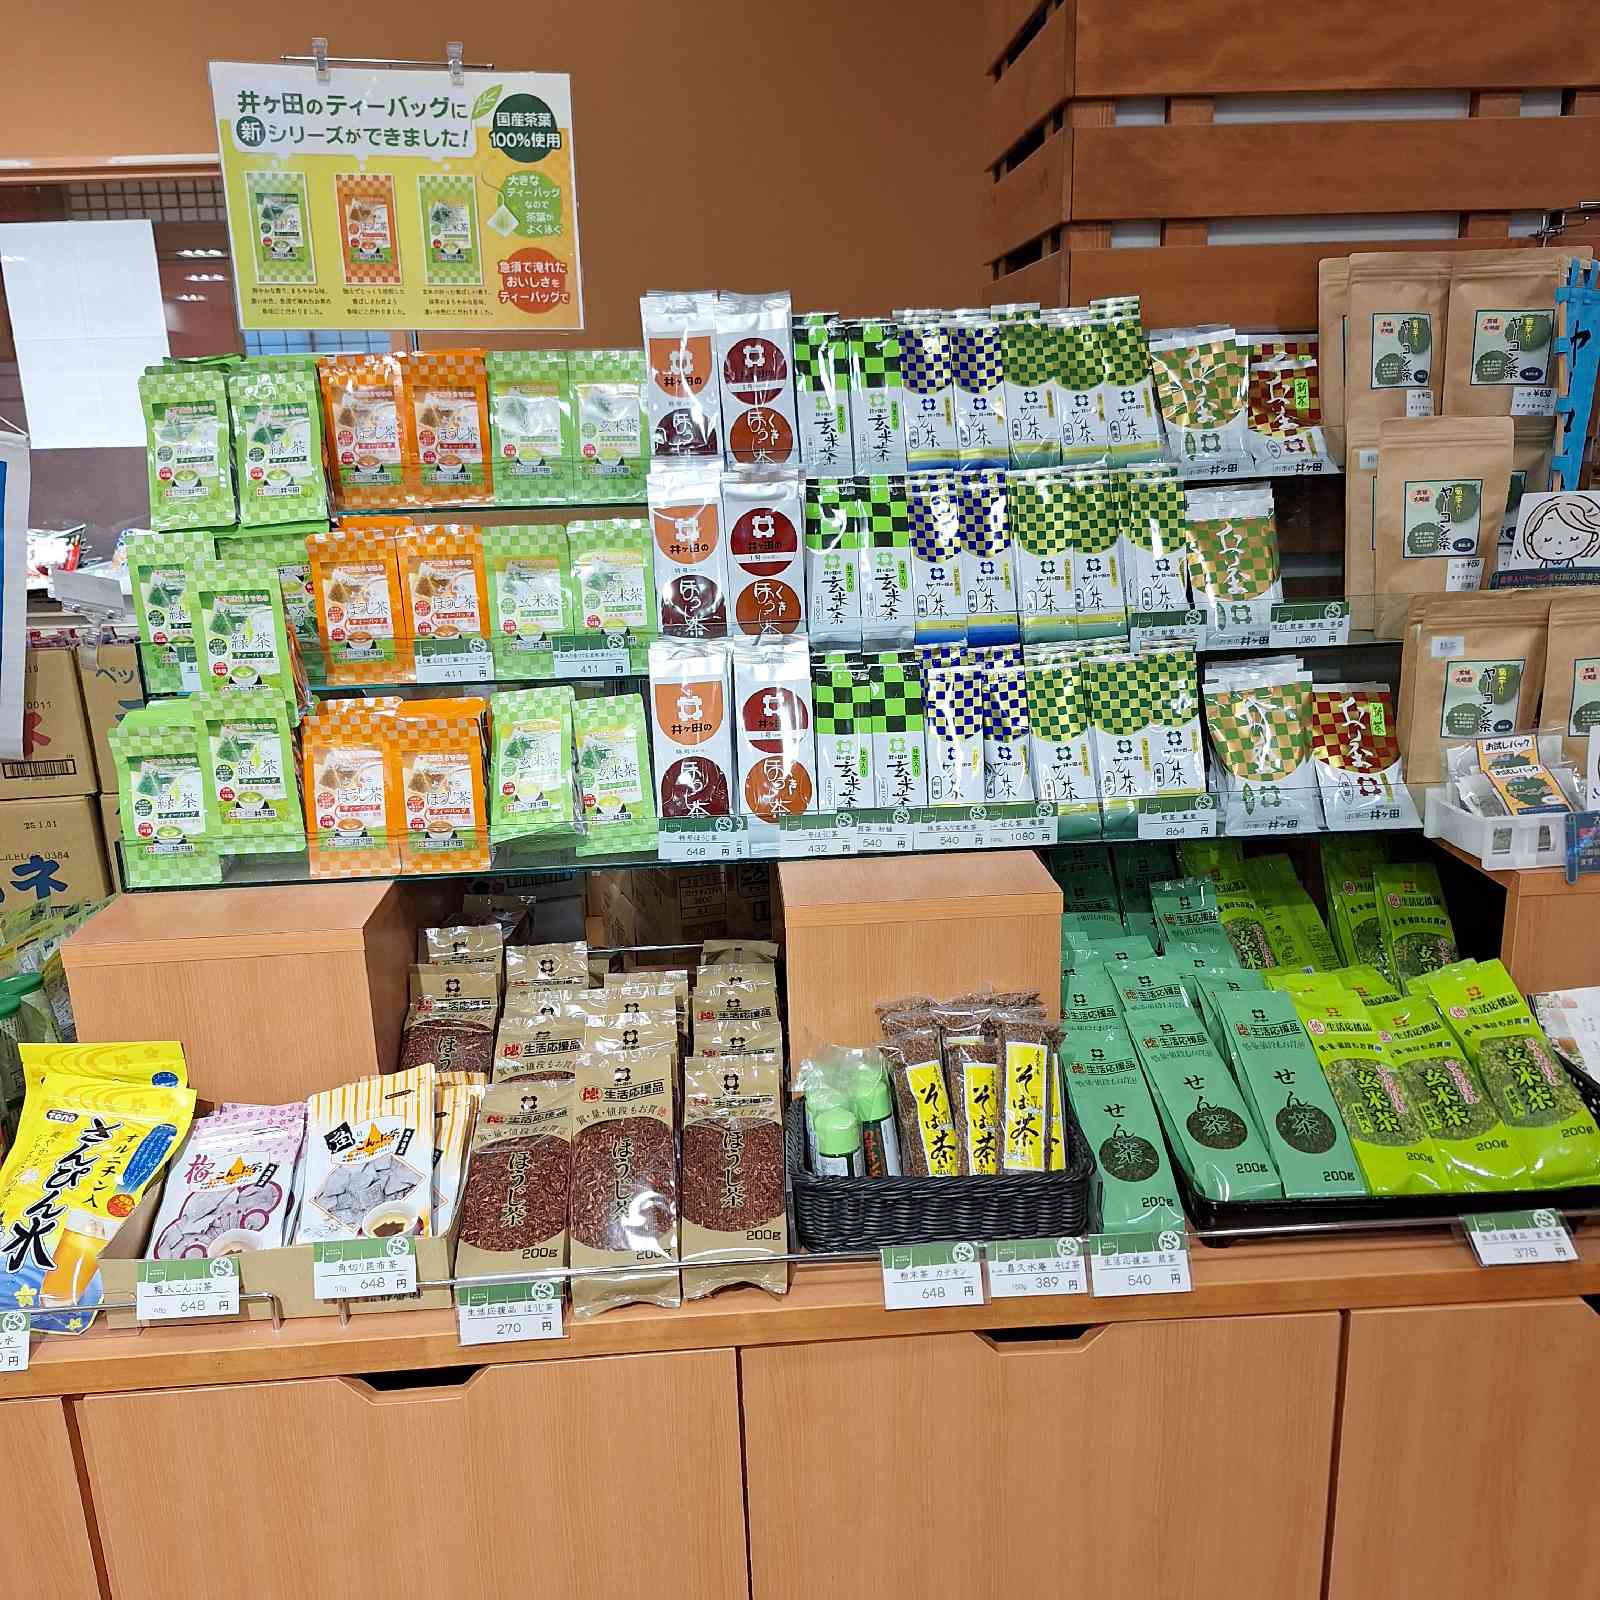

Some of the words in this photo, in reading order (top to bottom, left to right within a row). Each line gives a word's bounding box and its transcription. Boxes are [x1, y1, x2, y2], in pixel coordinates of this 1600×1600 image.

[237, 89, 468, 121] 井ヶ田のティーバッグに
[496, 112, 552, 128] 国産茶葉
[490, 132, 561, 149] 100%使用
[507, 175, 540, 186] 大きな
[506, 187, 561, 198] ティーバッグ
[524, 200, 549, 210] なので
[500, 261, 566, 274] 急須で淹れた
[506, 276, 560, 289] おいしさを
[500, 291, 569, 305] ティーバッグで
[1401, 319, 1413, 382] ヤーコン茶
[1504, 317, 1522, 379] ヤーコン茶
[599, 418, 639, 433] 玄米茶
[437, 426, 479, 442] ほうじ茶
[867, 414, 895, 463] 玄米茶
[814, 416, 840, 467] 玄米茶
[1209, 463, 1239, 474] 井ヶ田
[1295, 462, 1323, 473] 井ヶ田
[1439, 486, 1453, 551] ヤーコン茶
[669, 544, 709, 554] 井ヶ田の
[432, 596, 475, 610] ほうじ茶
[518, 594, 559, 609] 玄米茶
[602, 588, 643, 604] 玄米茶
[821, 575, 849, 625] 玄米茶
[874, 573, 901, 621] 玄米茶
[231, 632, 272, 650] 緑茶
[1240, 635, 1270, 646] 井ヶ田
[1328, 634, 1338, 643] 円
[479, 669, 487, 678] 円
[615, 665, 624, 674] 円
[1480, 668, 1496, 733] ヤーコン茶
[671, 723, 713, 735] 井ヶ田の
[1485, 739, 1531, 751] お試しパック
[238, 759, 279, 777] 緑茶
[597, 763, 638, 781] 玄米茶
[1495, 766, 1539, 776] お試しパック
[157, 792, 198, 810] 緑茶
[336, 786, 383, 803] ほうじ茶
[427, 791, 471, 807] ほうじ茶
[1370, 809, 1400, 819] 井ヶ田
[1165, 826, 1186, 837] 864
[1200, 826, 1209, 836] 円
[1269, 819, 1298, 830] 井ヶ田
[863, 838, 882, 848] 540
[897, 840, 906, 849] 円
[939, 836, 960, 846] 540
[975, 835, 983, 845] 円
[1010, 832, 1035, 842] 1080
[1041, 832, 1050, 842] 円
[686, 846, 706, 856] 648
[721, 847, 730, 856] 円
[808, 844, 828, 854] 432
[842, 844, 850, 853] 円
[1174, 911, 1218, 926] 生活応援品
[1137, 986, 1182, 1002] 生活応援品
[1070, 1008, 1118, 1021] 生活応援品
[1250, 1024, 1301, 1038] 生活応援品
[523, 1039, 582, 1056] 生活応援品
[1160, 1034, 1208, 1048] 生活応援品
[1086, 1059, 1137, 1074] 生活応援品
[1503, 1045, 1555, 1113] 玄米茶
[604, 1080, 665, 1100] 生活応援品
[1274, 1068, 1320, 1137] せん茶
[1354, 1069, 1402, 1133] 玄米茶
[1421, 1068, 1472, 1128] 玄米茶
[1010, 1063, 1040, 1148] そば茶
[1184, 1074, 1232, 1137] せん茶
[920, 1082, 956, 1165] そば茶
[973, 1084, 996, 1164] そば茶
[1103, 1103, 1144, 1164] せん茶
[1560, 1125, 1595, 1139] 200g
[1476, 1140, 1509, 1153] 200g
[1405, 1151, 1435, 1164] 200g
[84, 1133, 139, 1209] オルニチン入
[720, 1129, 745, 1209] ほうじ茶
[1235, 1162, 1270, 1175] 200g
[1323, 1170, 1356, 1183] 200g
[501, 1151, 530, 1227] ほうじ茶
[1141, 1196, 1175, 1208] 200g
[745, 1229, 782, 1241] 200g
[521, 1246, 558, 1260] 200g
[1513, 1247, 1538, 1258] 378
[1554, 1246, 1567, 1257] 円
[337, 1259, 400, 1273] 角切り昆布茶
[936, 1267, 968, 1278] カテキン
[1055, 1260, 1080, 1271] そば茶
[359, 1276, 386, 1290] 648
[396, 1278, 407, 1289] 円
[1035, 1277, 1059, 1289] 389
[1068, 1279, 1078, 1291] 円
[1127, 1274, 1152, 1287] 540
[1171, 1273, 1181, 1285] 円
[921, 1286, 946, 1299] 648
[964, 1285, 974, 1297] 円
[179, 1299, 206, 1312] 648
[218, 1299, 230, 1311] 円
[495, 1322, 522, 1336] 270
[541, 1320, 553, 1332] 円
[8, 1356, 19, 1367] 円
